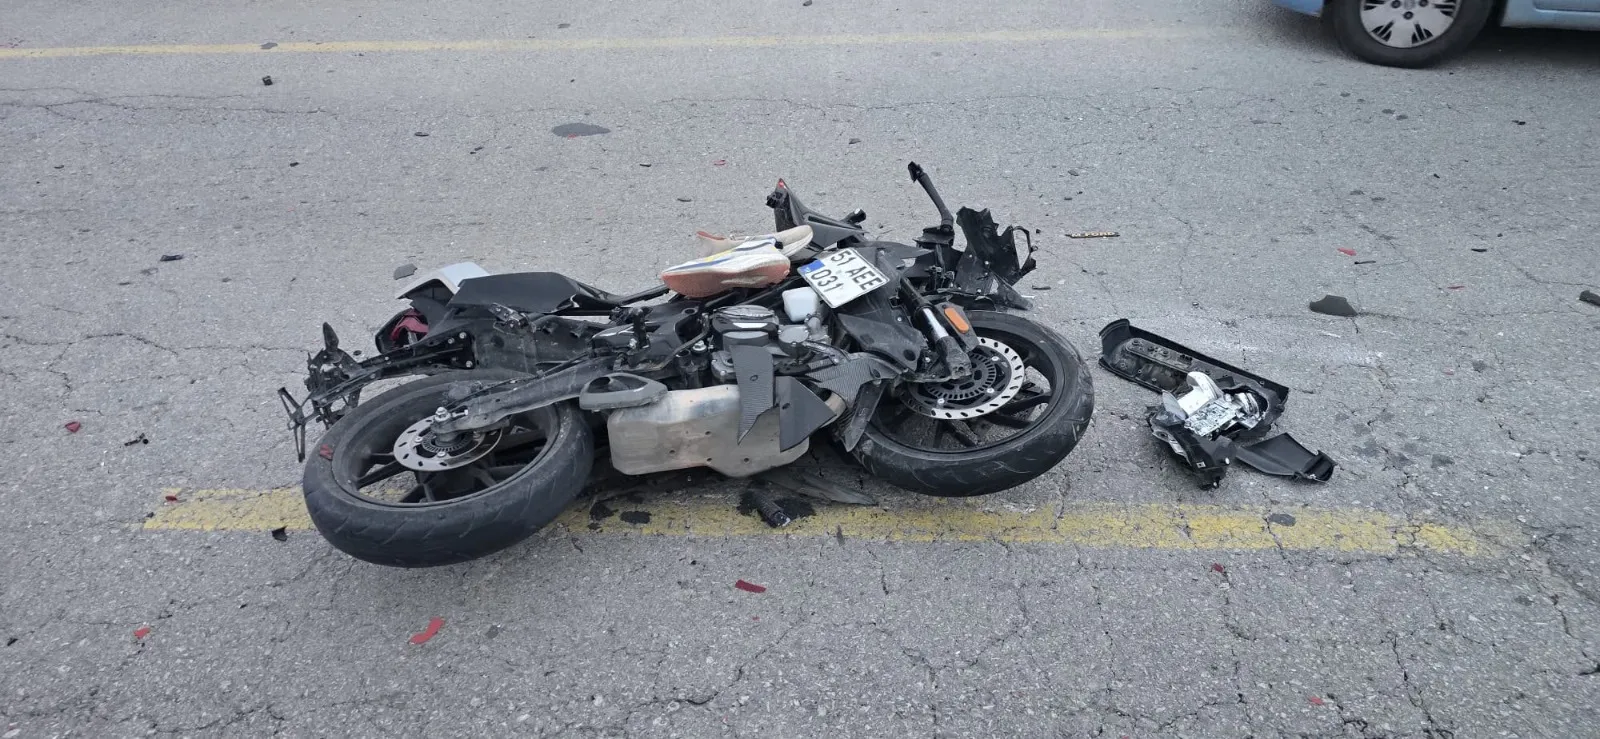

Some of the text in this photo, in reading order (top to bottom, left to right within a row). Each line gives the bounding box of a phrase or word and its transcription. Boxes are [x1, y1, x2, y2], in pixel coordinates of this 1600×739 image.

[810, 269, 844, 293] 031
[830, 250, 883, 290] 51 AEE
